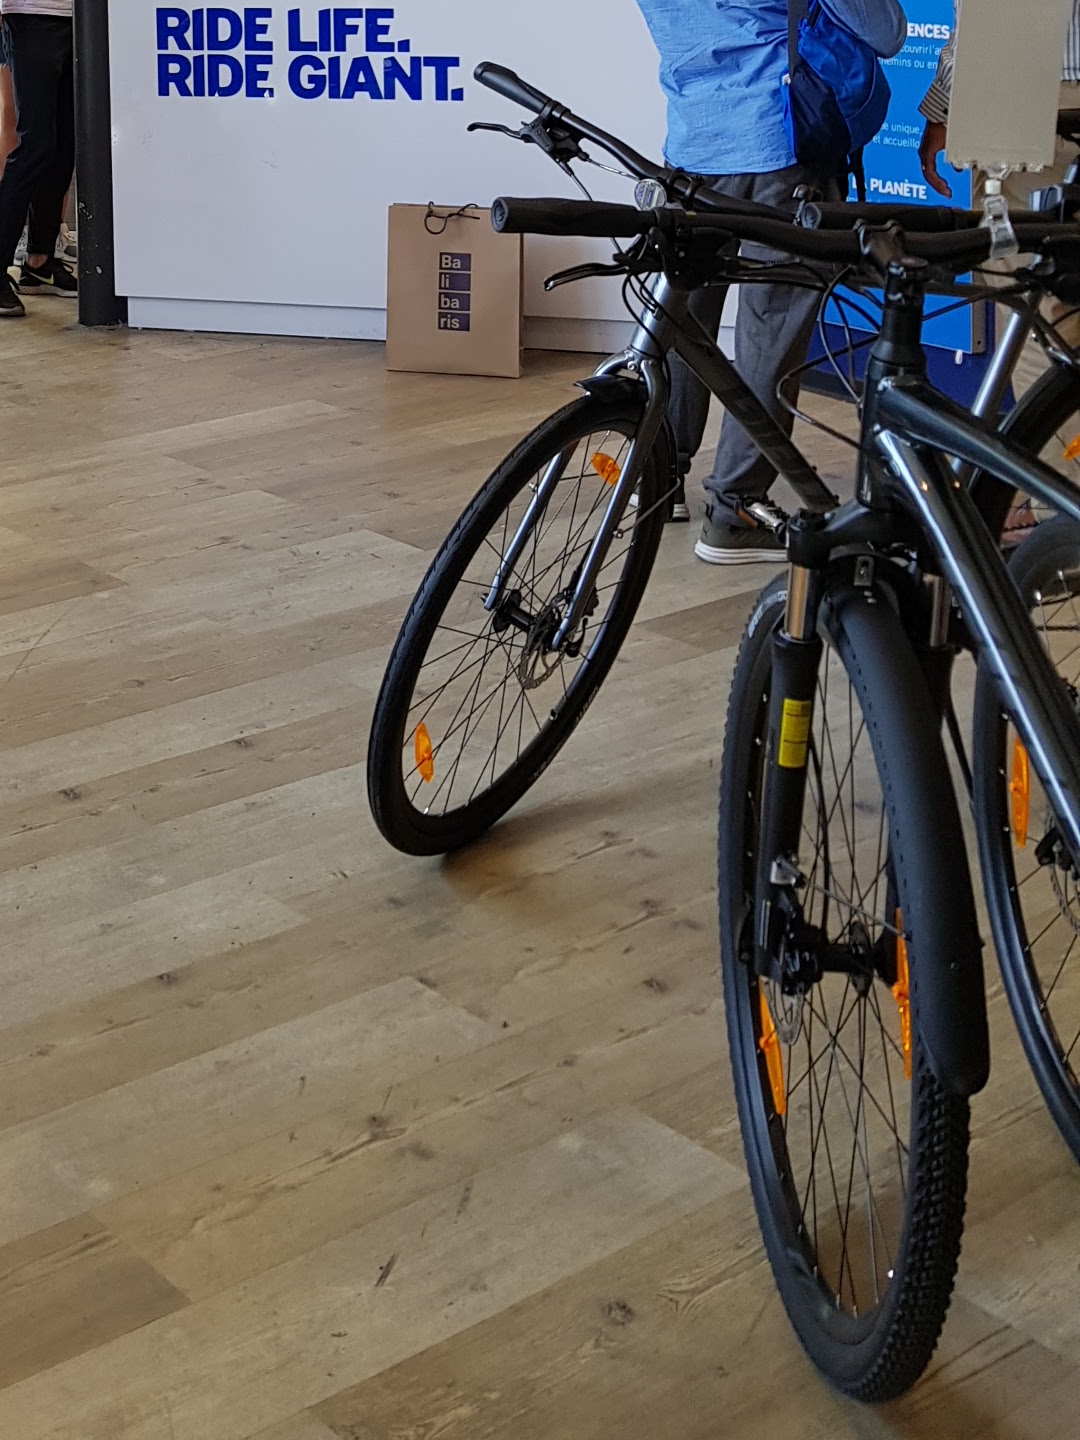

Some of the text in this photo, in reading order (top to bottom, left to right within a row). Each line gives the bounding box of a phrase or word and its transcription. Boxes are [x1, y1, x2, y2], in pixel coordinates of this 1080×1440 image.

[156, 7, 411, 53] RIDE LIFE.
[914, 61, 925, 69] ou
[157, 54, 465, 101] RIDE GIANT.
[883, 135, 920, 149] accueillo
[870, 177, 928, 200] PLANÈTE
[441, 254, 462, 269] Ba
[440, 273, 450, 288] li
[440, 293, 460, 308] ba
[440, 314, 460, 329] ris
